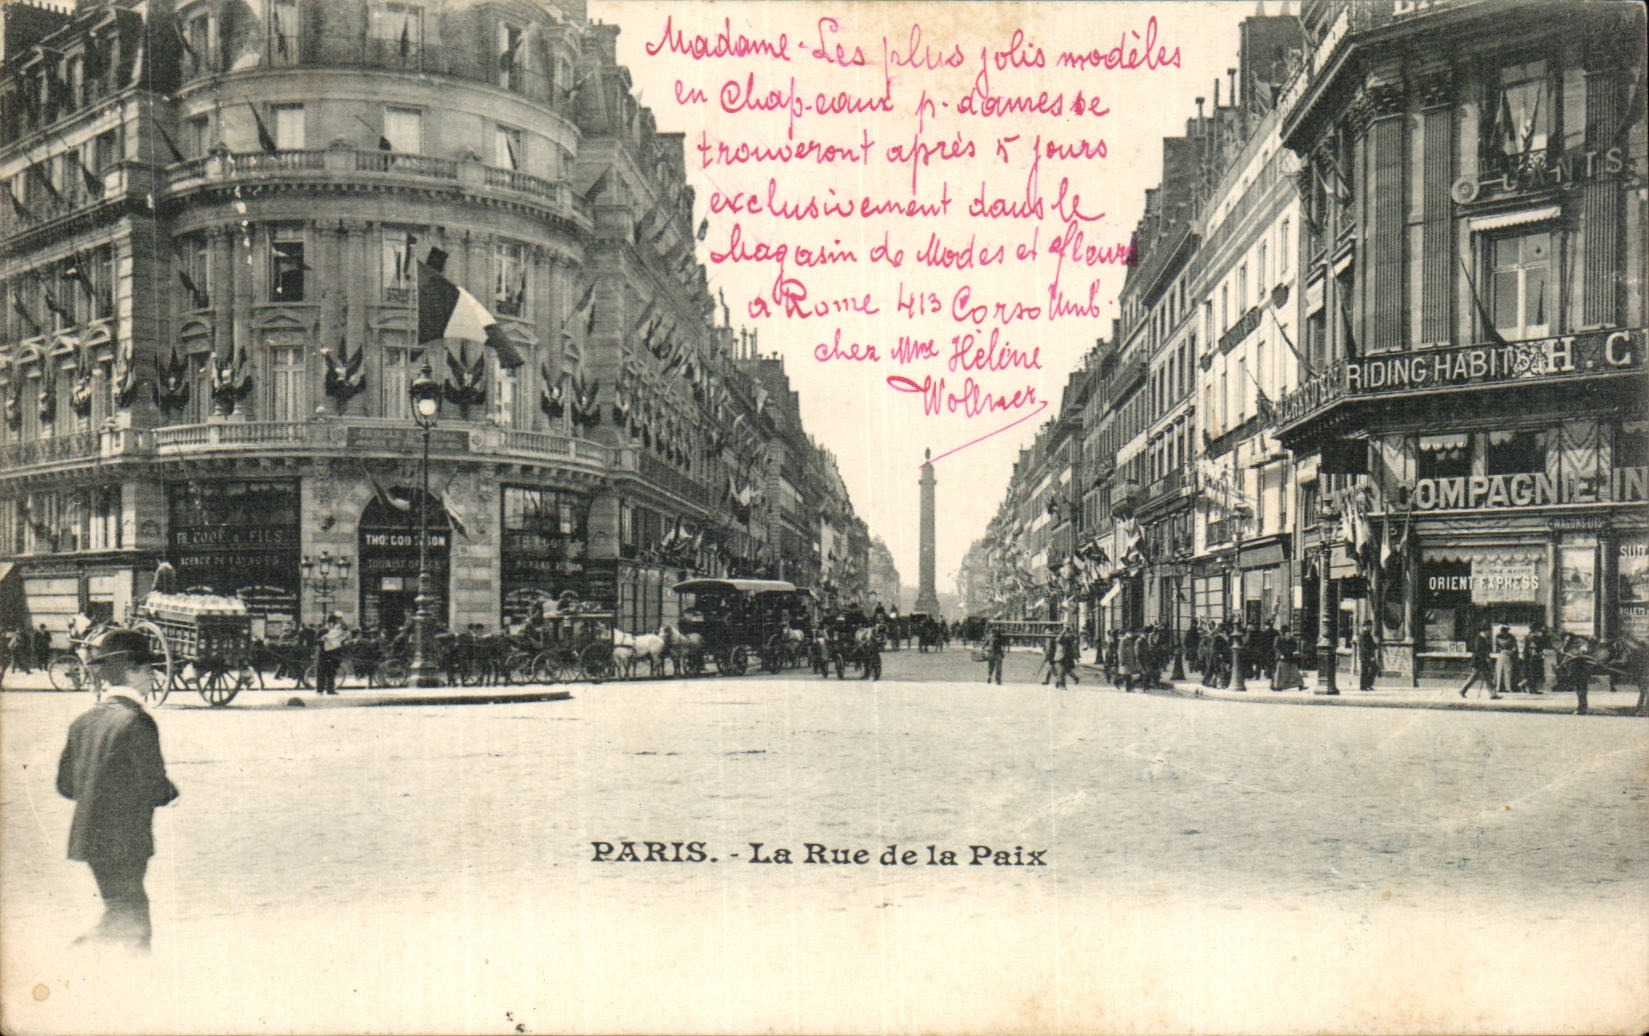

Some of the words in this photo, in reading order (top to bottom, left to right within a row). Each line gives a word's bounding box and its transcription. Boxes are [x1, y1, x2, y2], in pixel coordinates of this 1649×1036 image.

[645, 15, 791, 60] Madame
[812, 16, 866, 66] Les
[882, 23, 964, 86] plus
[975, 28, 1046, 99] jolis
[1056, 15, 1182, 70] modèles
[674, 79, 708, 104] en
[696, 128, 876, 169] trouveront
[886, 131, 976, 196] après
[996, 134, 1021, 164] 5
[1026, 134, 1108, 213] jours
[710, 177, 953, 221] exclusivement
[968, 180, 1045, 221] dans
[1050, 177, 1106, 223] le
[710, 223, 858, 306] Magasin
[869, 230, 905, 268] de
[916, 232, 1005, 270] Modes
[1015, 226, 1038, 262] et
[780, 278, 880, 319] Rome
[896, 281, 943, 320] 413
[952, 285, 1042, 325] Corso
[814, 327, 881, 363] chez
[1345, 357, 1428, 392] RIDING
[1434, 345, 1533, 383] HABITS
[1398, 468, 1599, 512] COMPAGNIE
[1428, 576, 1474, 591] ORIENT
[1479, 575, 1540, 590] EXPRESS
